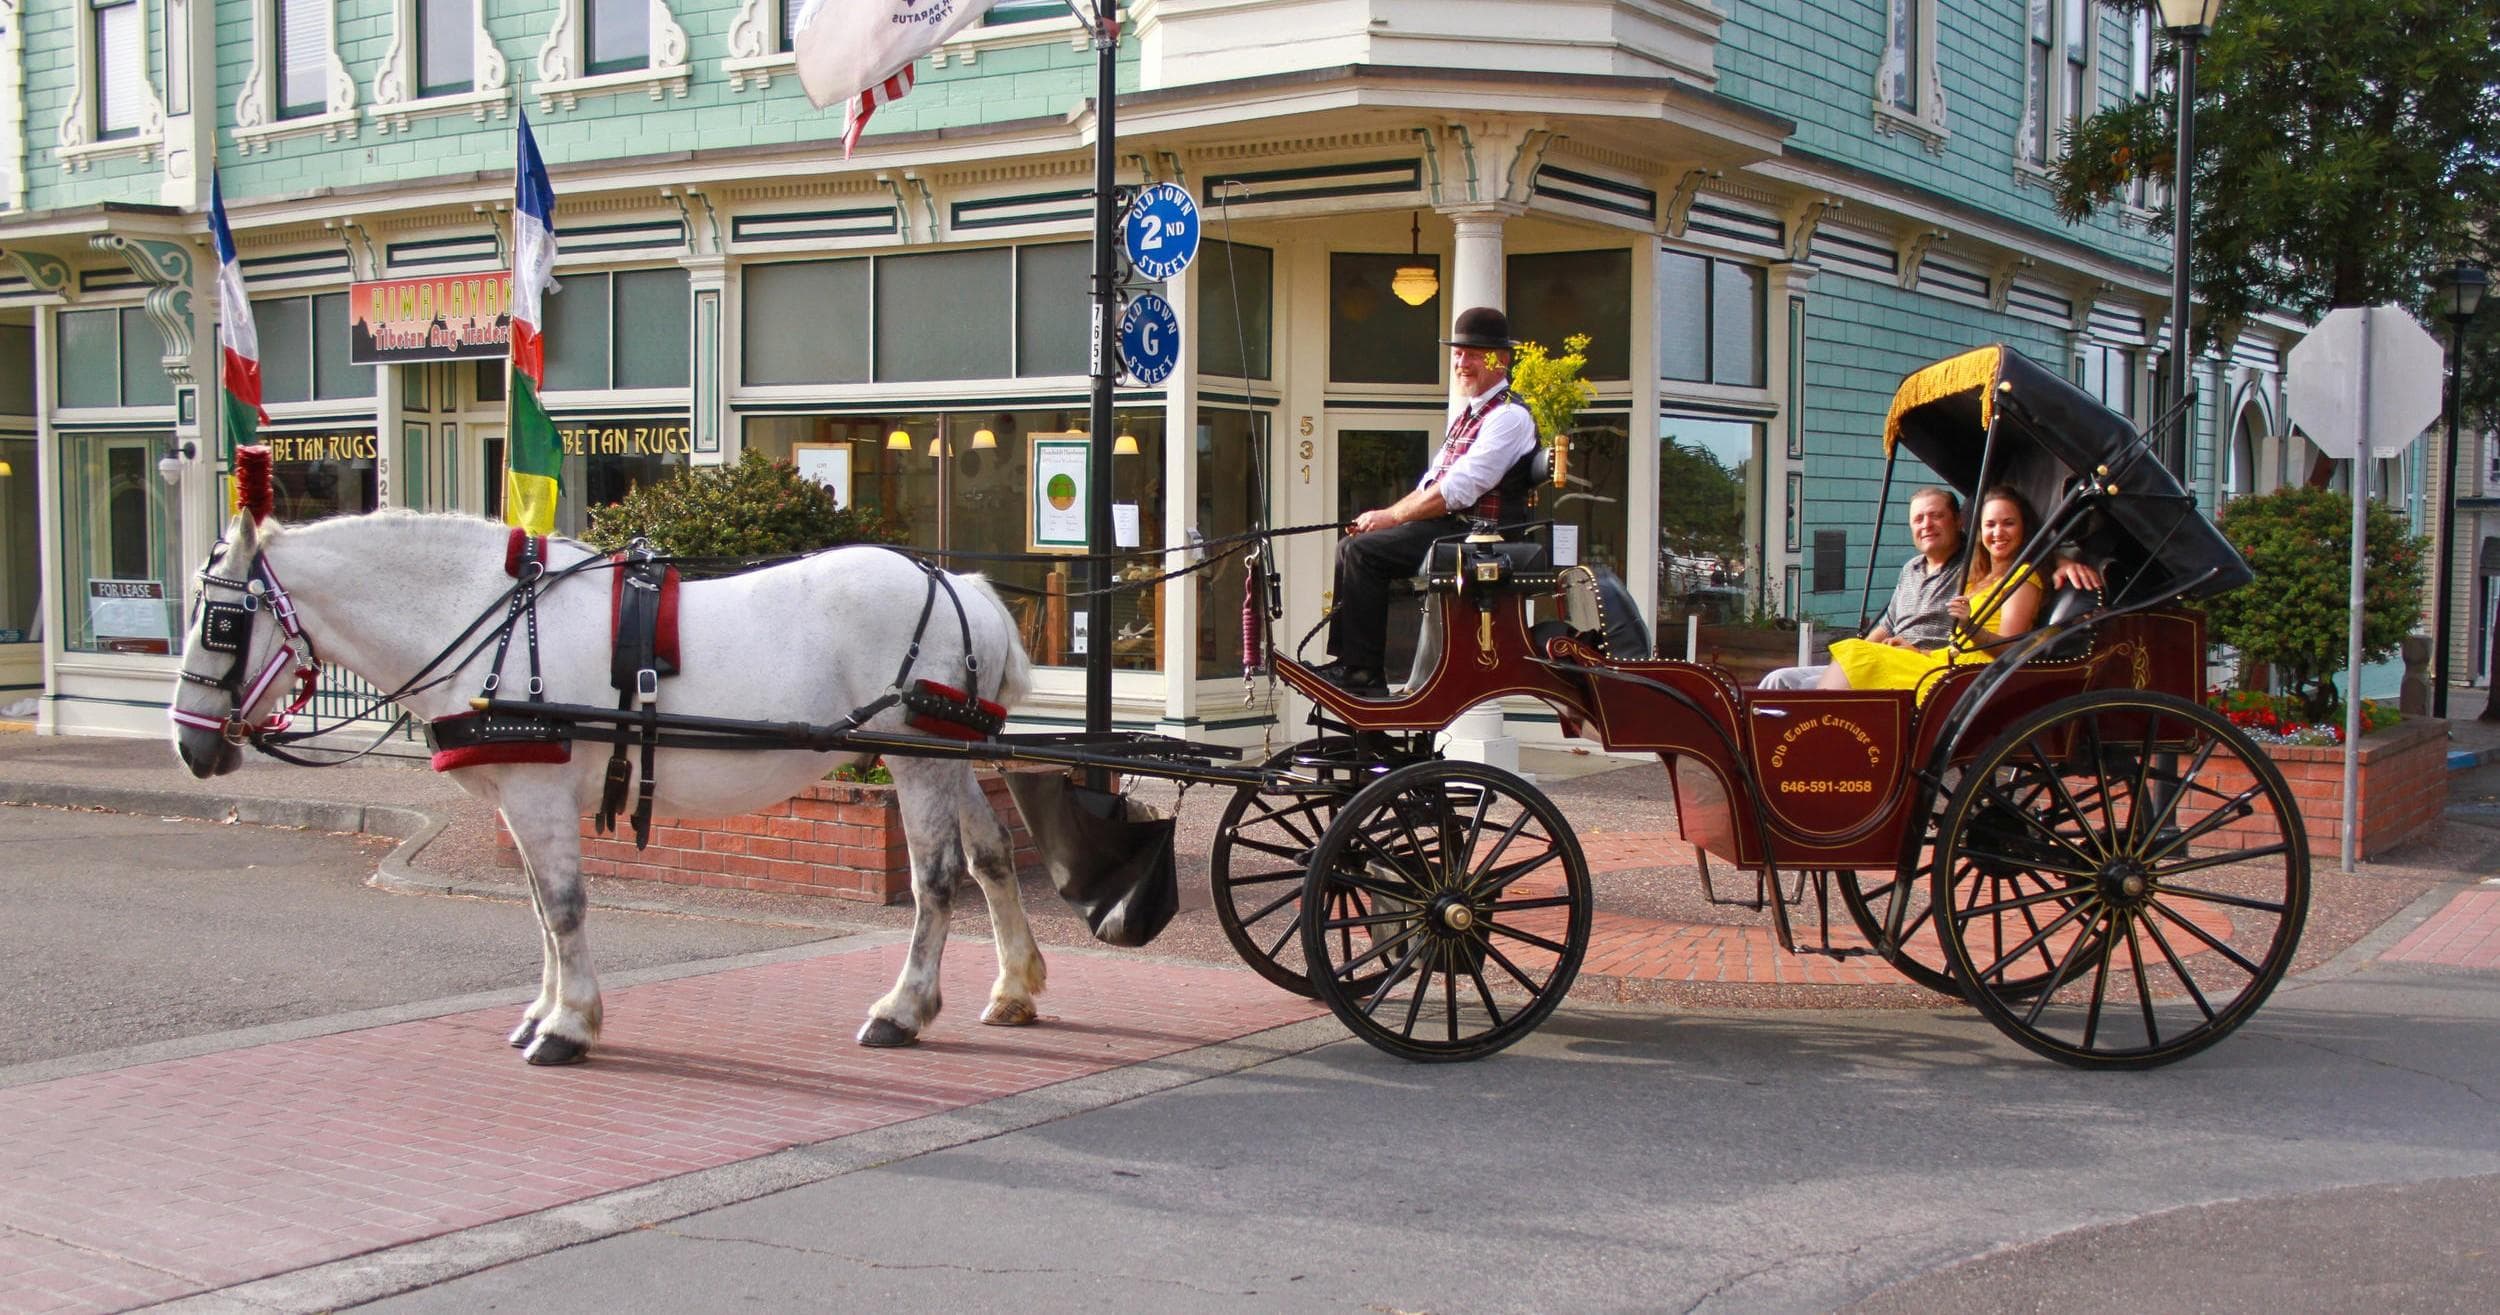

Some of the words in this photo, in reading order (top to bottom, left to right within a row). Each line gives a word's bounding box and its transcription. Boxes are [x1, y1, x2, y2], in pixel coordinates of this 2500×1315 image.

[1132, 191, 1154, 220] OLD
[1158, 187, 1193, 217] TOWN
[1138, 251, 1188, 277] STREET
[1124, 302, 1142, 334] OLD
[1145, 297, 1177, 335] TOWN
[375, 326, 427, 350] Tibetan
[430, 325, 457, 351] Rug
[1142, 322, 1159, 356] G
[1128, 354, 1174, 384] STREET
[329, 435, 377, 460] RUGS
[559, 428, 628, 455] BETAN
[635, 427, 690, 455] RUGS
[1300, 416, 1314, 484] 531
[98, 583, 119, 597] FOR
[120, 584, 152, 598] LEASE
[1771, 744, 1788, 768] Old
[1783, 719, 1818, 742] Town
[1822, 714, 1871, 745] Carriage
[1867, 745, 1881, 768] Co.
[1781, 781, 1872, 793] 646-591-2058
